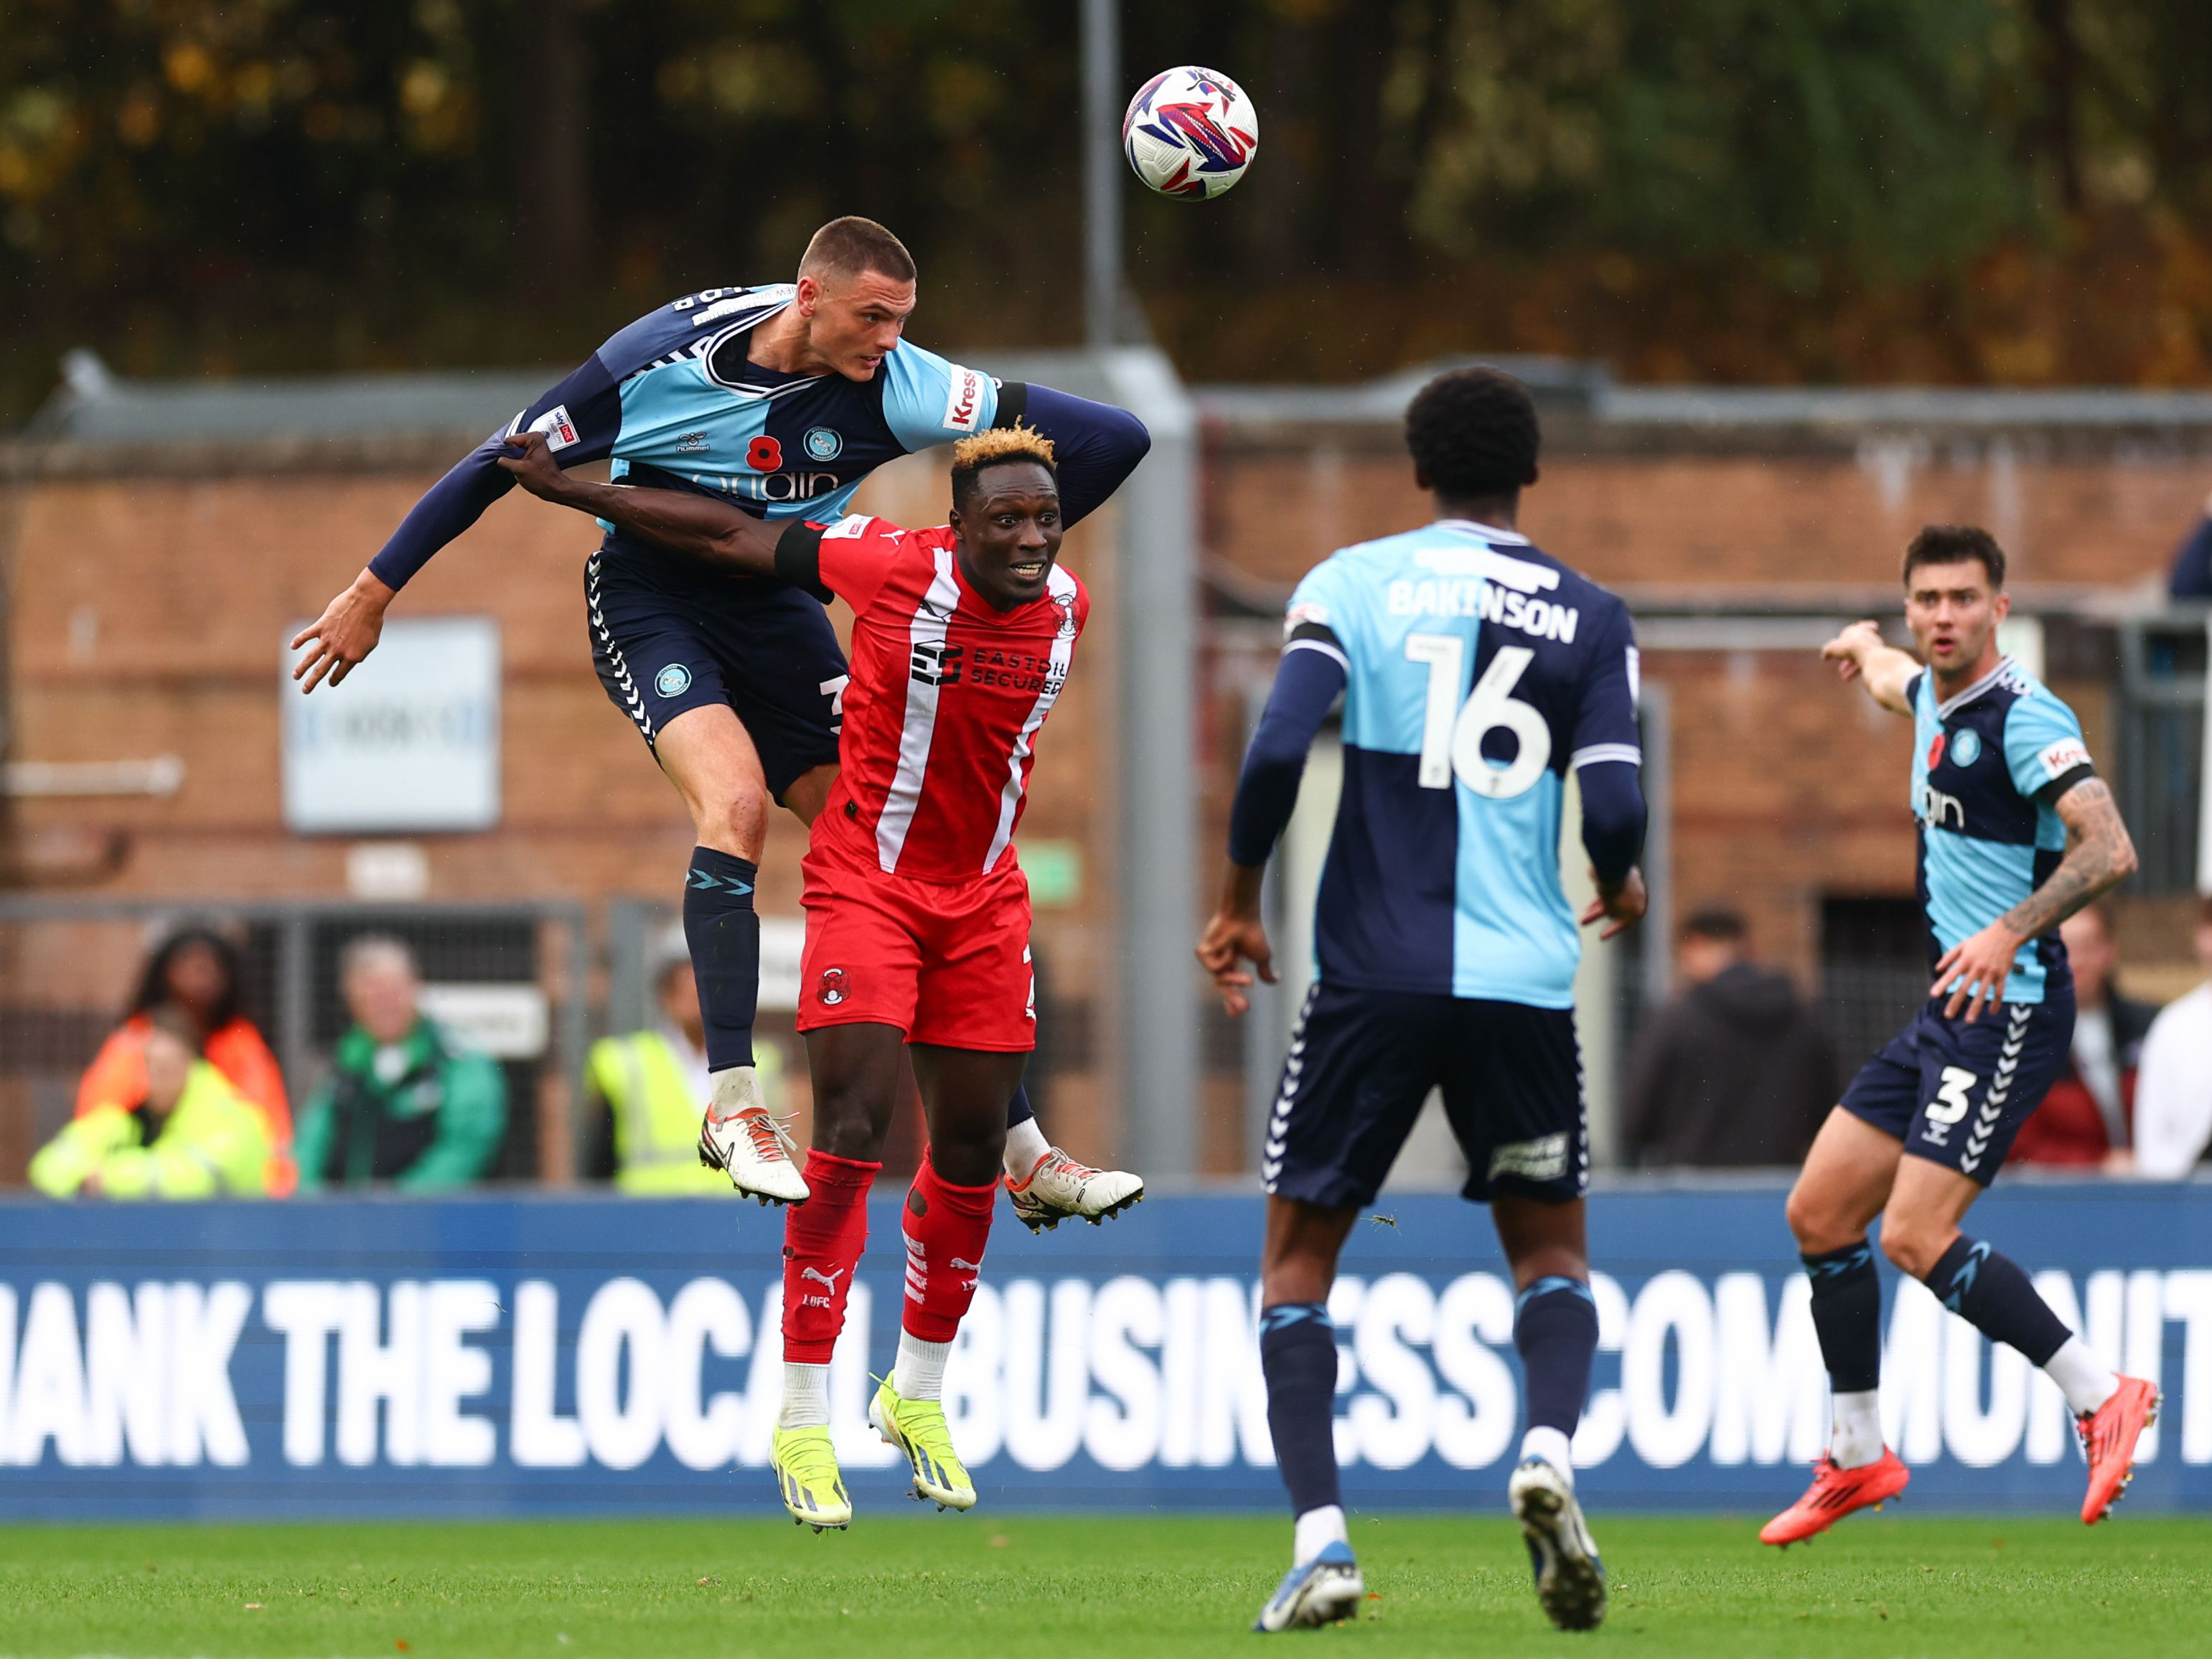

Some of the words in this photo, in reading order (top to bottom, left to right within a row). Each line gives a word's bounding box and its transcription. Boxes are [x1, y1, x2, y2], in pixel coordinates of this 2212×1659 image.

[952, 372, 976, 425] Kress
[555, 411, 565, 425] sky
[562, 426, 573, 441] bet
[1388, 578, 1579, 644] BAKINSON
[970, 669, 1062, 695] SECURED
[973, 649, 1065, 677] EASTDIL
[1405, 631, 1552, 799] 16
[1925, 1066, 1977, 1124] 3
[802, 1294, 830, 1309] LOFC
[0, 1281, 254, 1467] ANK
[263, 1279, 501, 1467] THE
